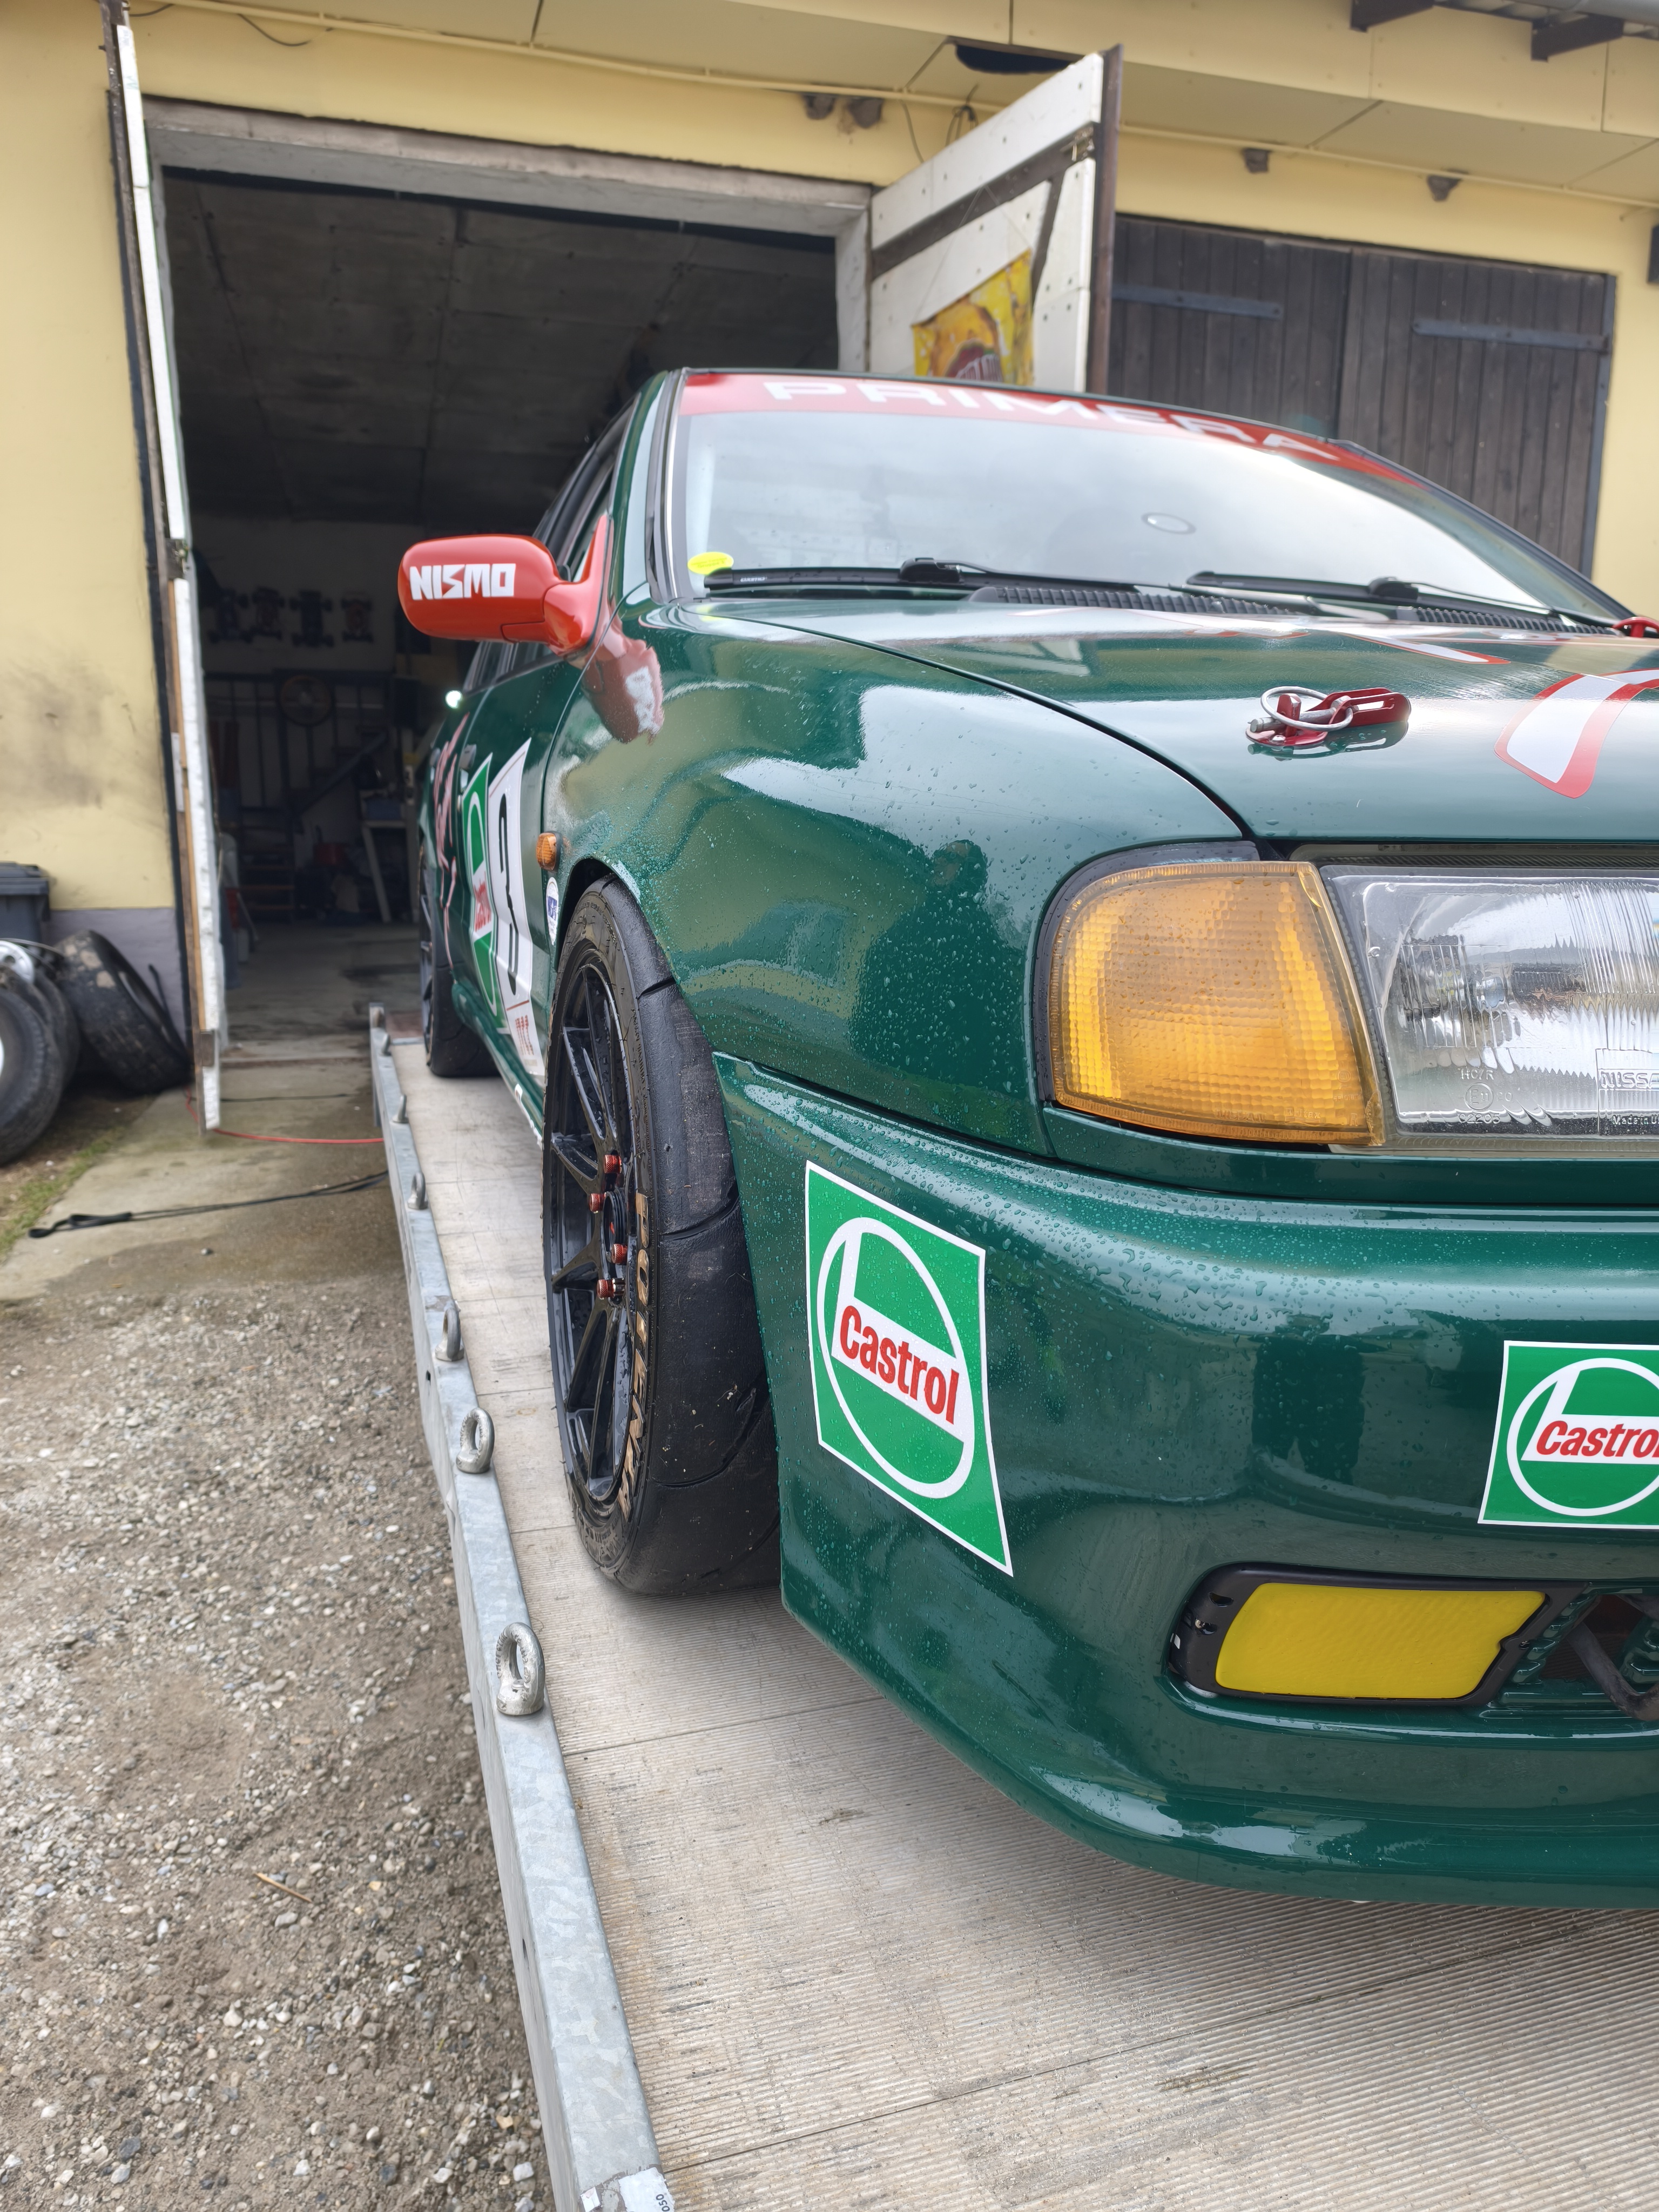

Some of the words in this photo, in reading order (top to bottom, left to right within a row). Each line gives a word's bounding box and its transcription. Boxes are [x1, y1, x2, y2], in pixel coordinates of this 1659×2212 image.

[763, 381, 1339, 461] PRIMERA
[409, 563, 516, 601] NISMO
[840, 1305, 959, 1425] Castrol
[1536, 1420, 1659, 1458] Castro
